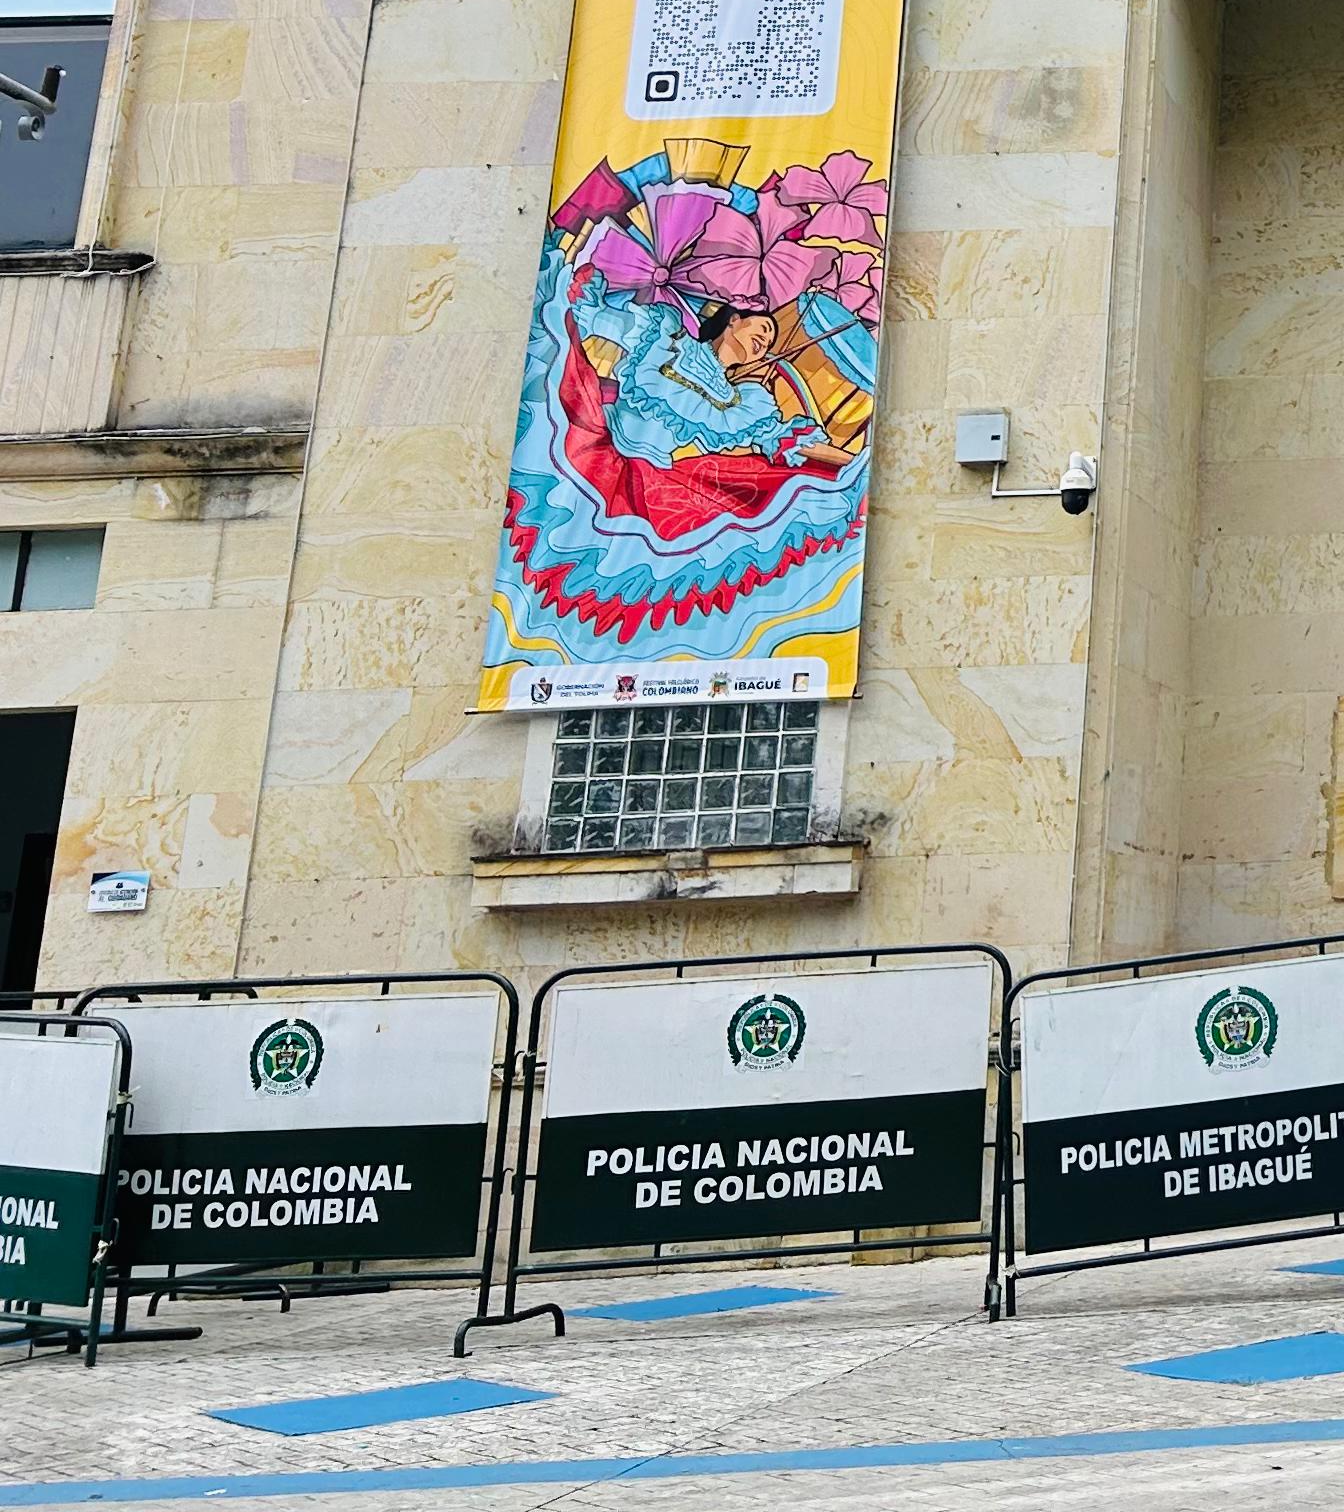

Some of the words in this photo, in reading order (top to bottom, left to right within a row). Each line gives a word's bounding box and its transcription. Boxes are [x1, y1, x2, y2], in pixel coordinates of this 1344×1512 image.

[734, 678, 782, 691] IBAGUÉ
[586, 1144, 726, 1177] POLICIA
[736, 1130, 915, 1168] NACIONAL
[1060, 1135, 1172, 1175] POLICIA
[1163, 1167, 1201, 1199] DE
[1207, 1145, 1313, 1193] IBAGUÉ
[244, 1164, 413, 1195] NACIONAL
[635, 1179, 682, 1209] DE
[692, 1165, 884, 1205] COLOMBIA
[0, 1195, 60, 1230] ONAL
[151, 1203, 193, 1230] DE
[203, 1196, 379, 1229] COLOMBIA
